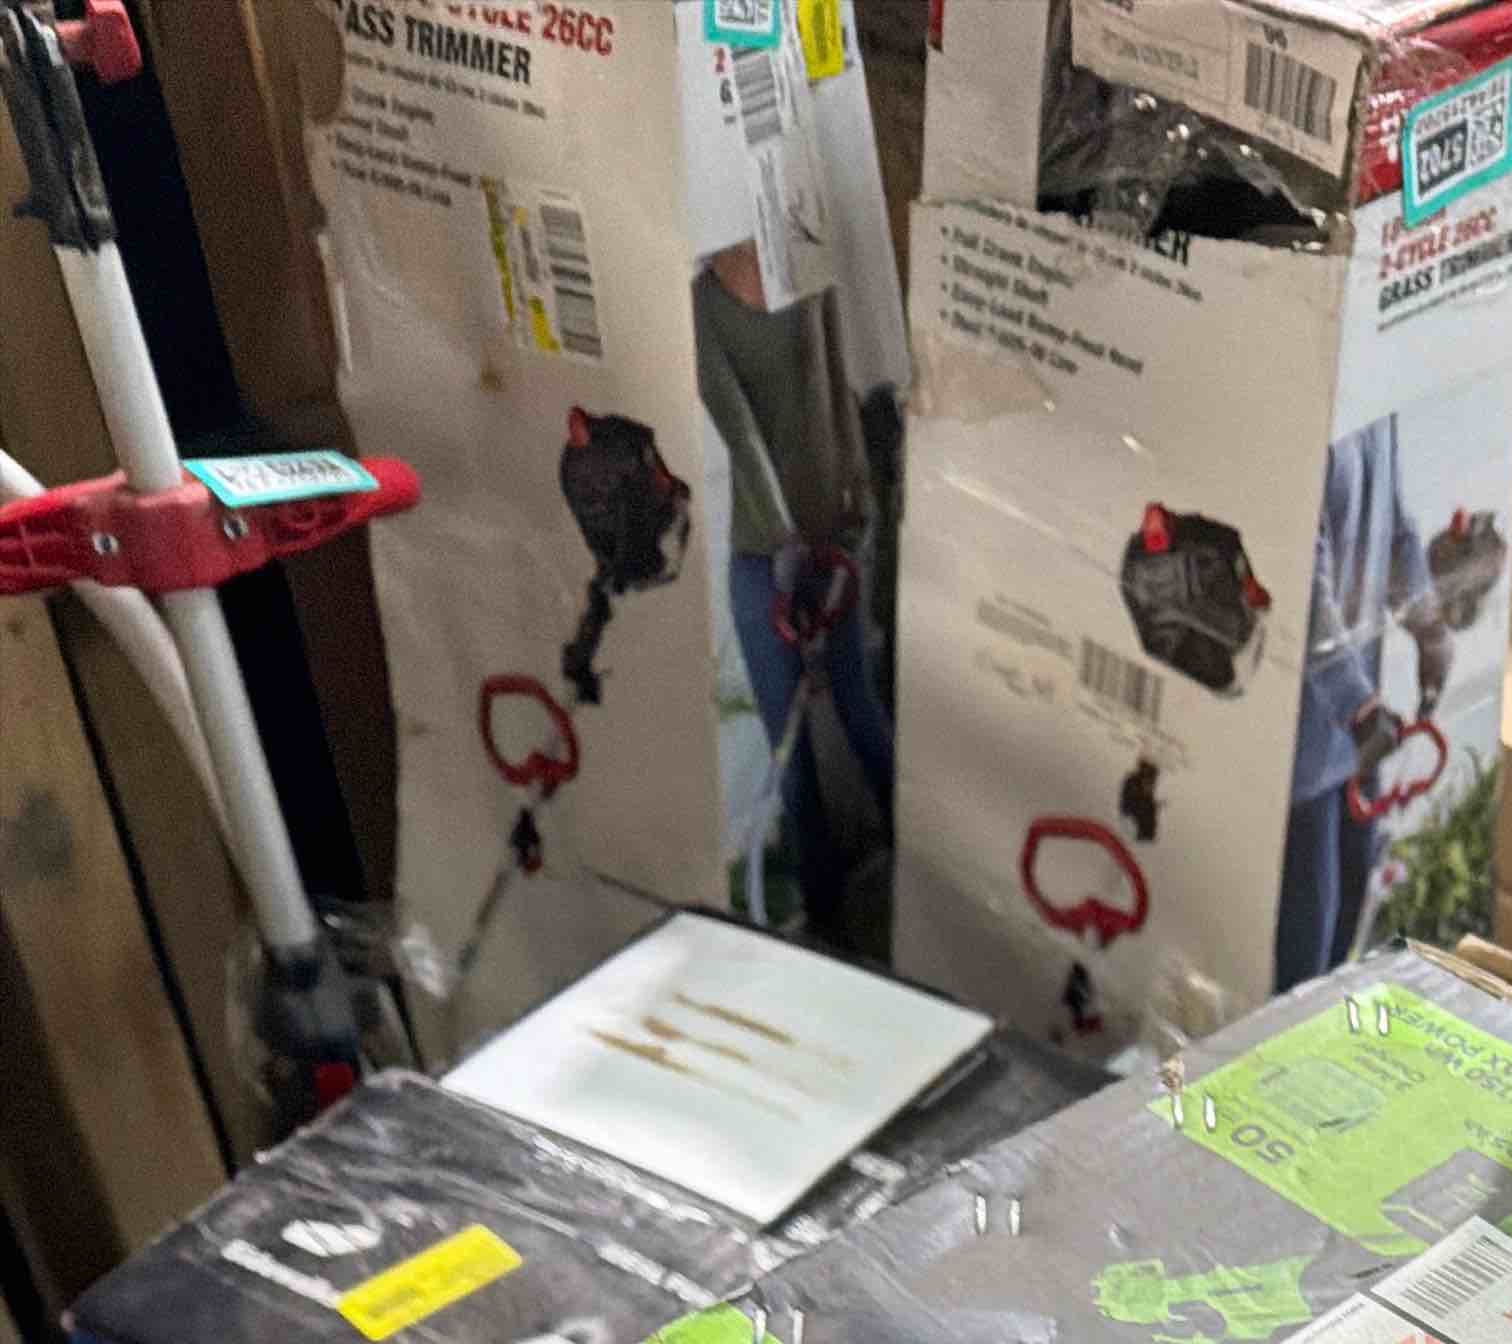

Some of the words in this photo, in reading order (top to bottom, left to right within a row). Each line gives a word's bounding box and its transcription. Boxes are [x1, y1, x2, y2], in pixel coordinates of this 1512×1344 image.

[338, 2, 395, 50] ASS
[403, 13, 532, 85] TRIMMER
[541, 3, 613, 57] 26CC
